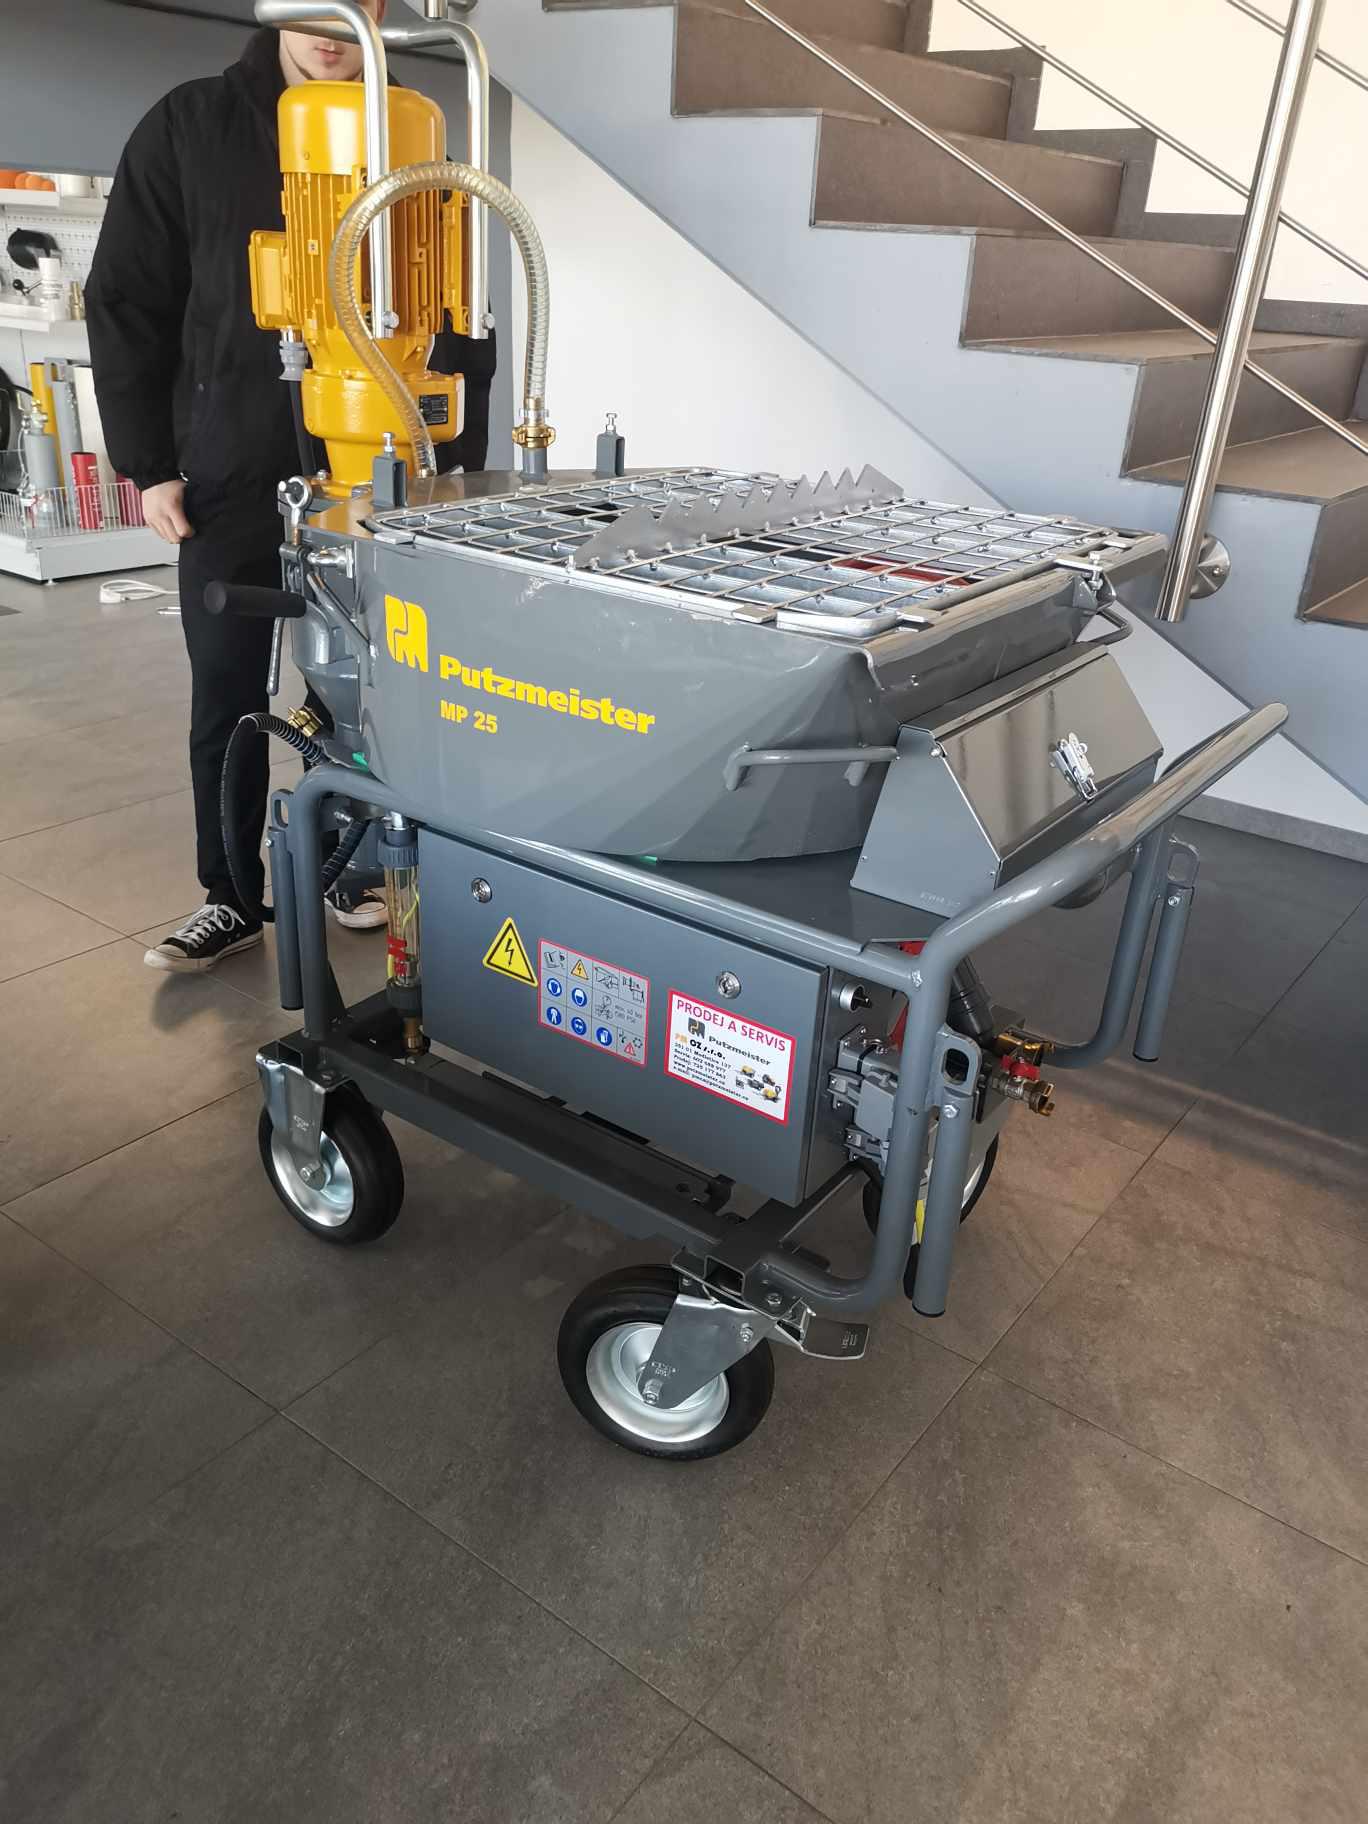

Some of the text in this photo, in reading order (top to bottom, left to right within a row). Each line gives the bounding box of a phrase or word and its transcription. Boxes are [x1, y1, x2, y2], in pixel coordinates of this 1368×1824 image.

[439, 654, 656, 735] Putzmeister
[440, 700, 498, 735] MP 25
[677, 999, 785, 1051] PRODEJ A SERVIS
[709, 1035, 771, 1066] Putzmeister
